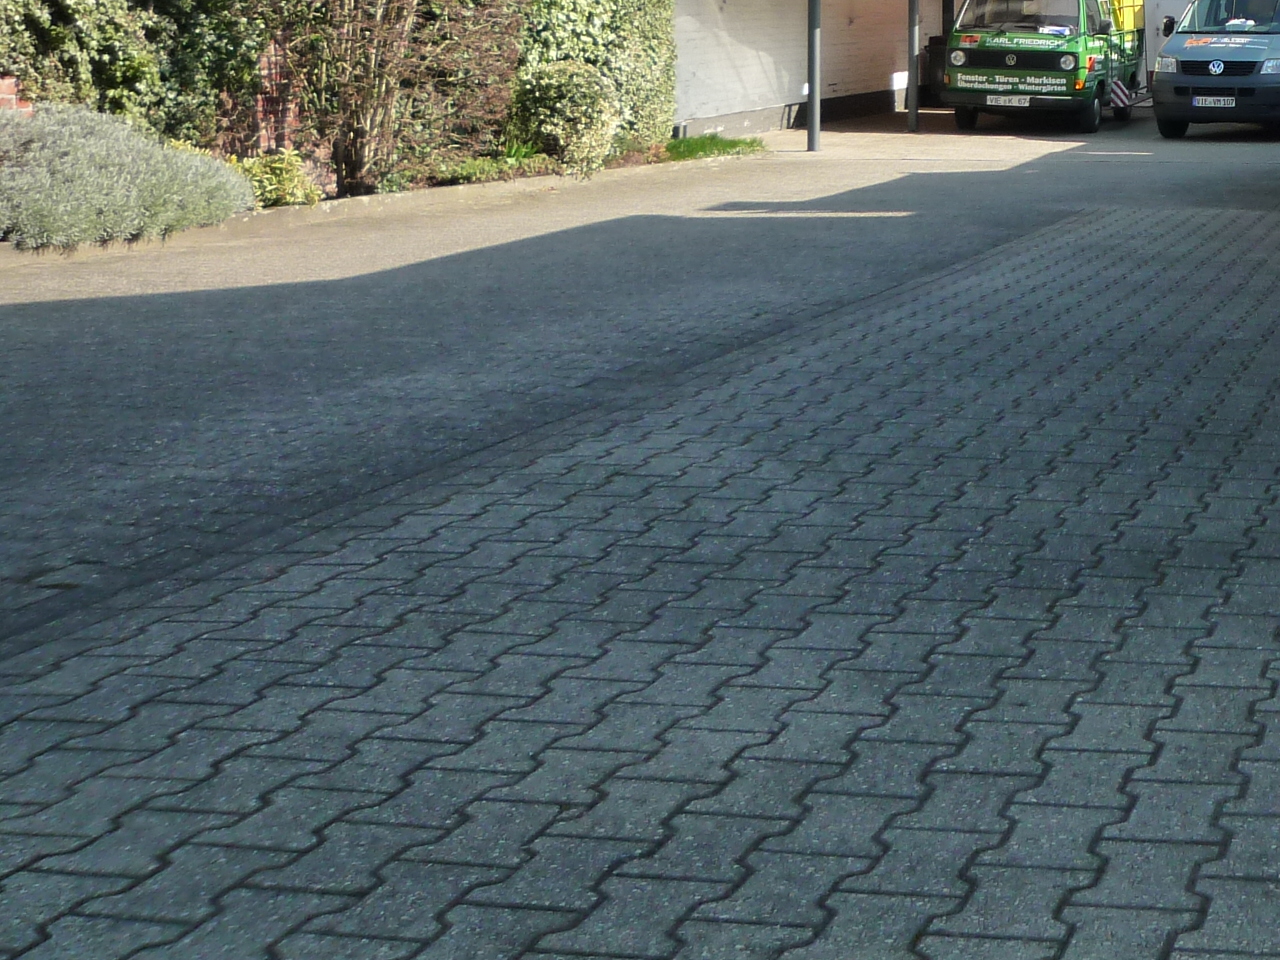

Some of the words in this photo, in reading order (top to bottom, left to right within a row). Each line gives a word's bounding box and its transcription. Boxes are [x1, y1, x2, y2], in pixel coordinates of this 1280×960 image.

[957, 73, 988, 81] Fenster
[994, 75, 1019, 83] Türen
[1026, 76, 1067, 84] Markisen
[957, 80, 1012, 91] Überdachungen
[1018, 84, 1067, 92] Wintergärten
